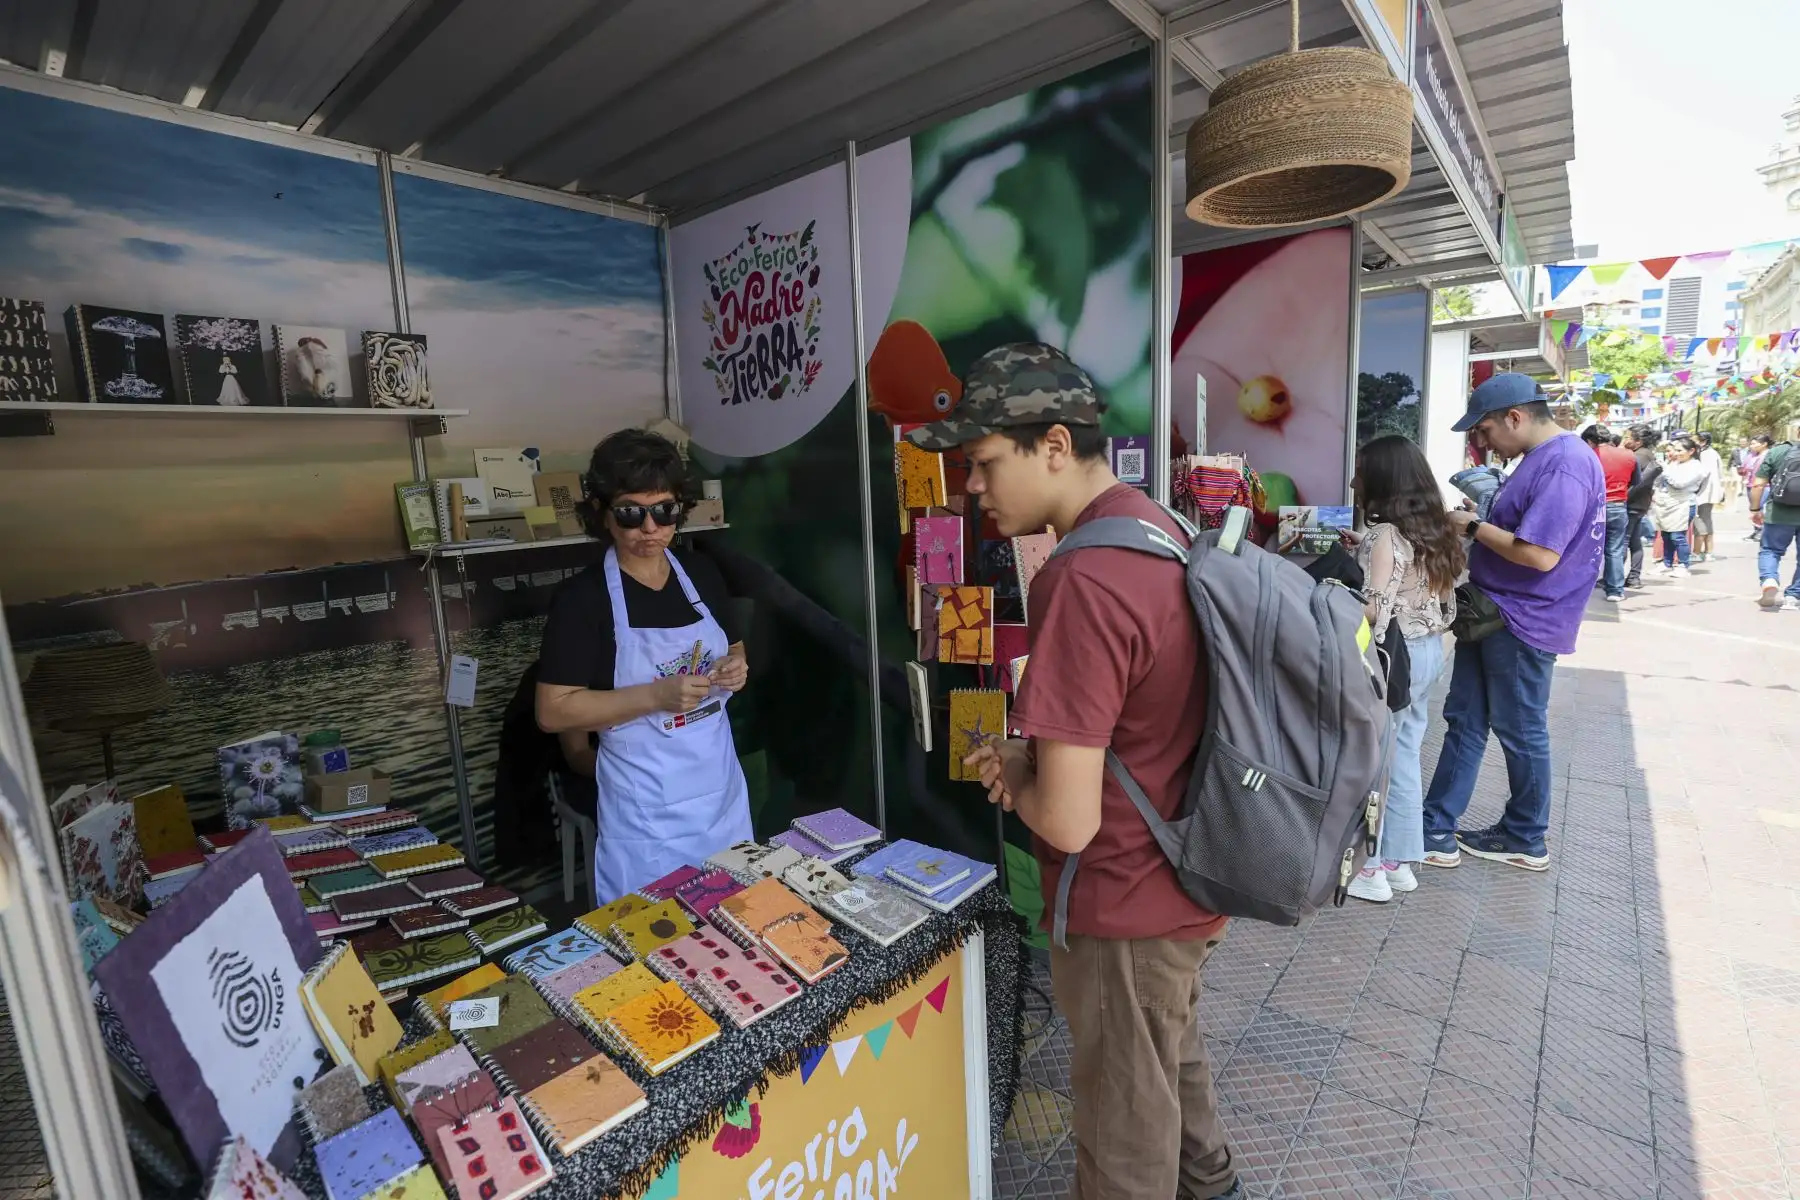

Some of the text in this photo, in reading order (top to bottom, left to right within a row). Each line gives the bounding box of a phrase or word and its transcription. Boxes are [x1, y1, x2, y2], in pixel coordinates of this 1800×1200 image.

[719, 271, 804, 345] Madre
[271, 966, 285, 1029] UNGA
[747, 1106, 868, 1200] Feria
